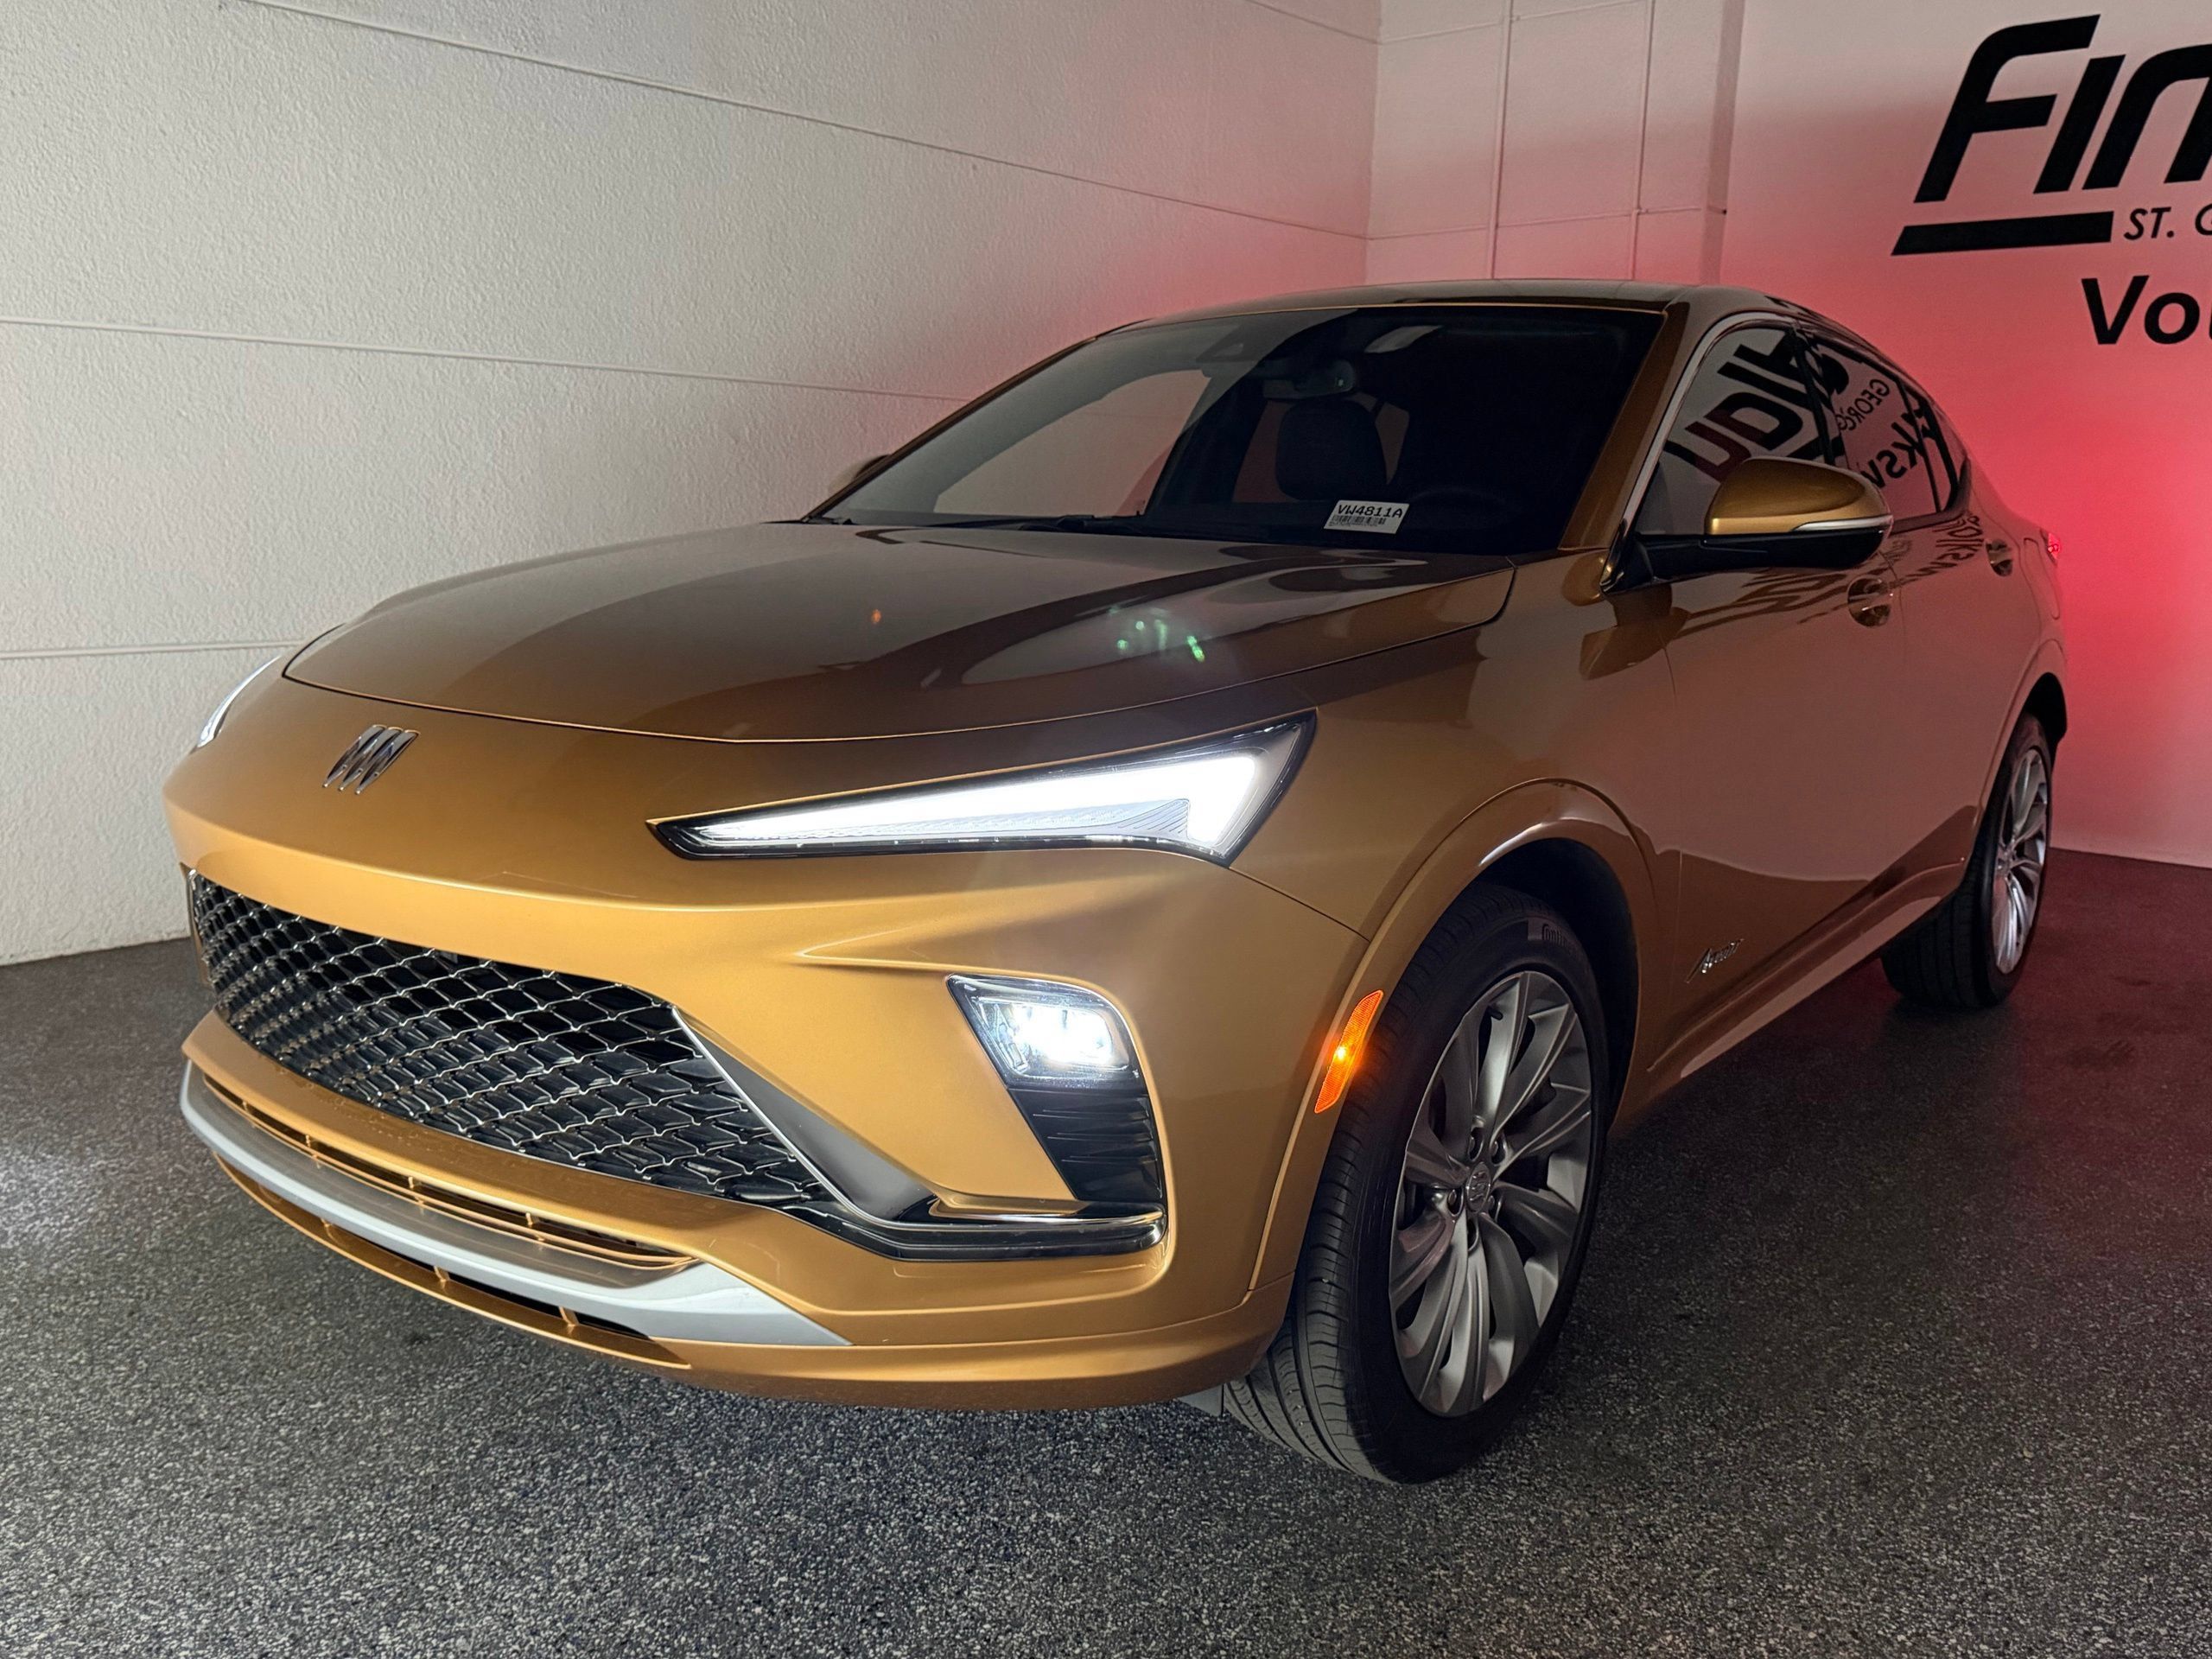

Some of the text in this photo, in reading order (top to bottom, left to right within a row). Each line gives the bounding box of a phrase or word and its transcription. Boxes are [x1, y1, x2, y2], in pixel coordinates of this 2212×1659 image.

[2123, 207, 2174, 240] ST.
[2082, 275, 2212, 345] Vo
[1338, 504, 1404, 518] VW4811A
